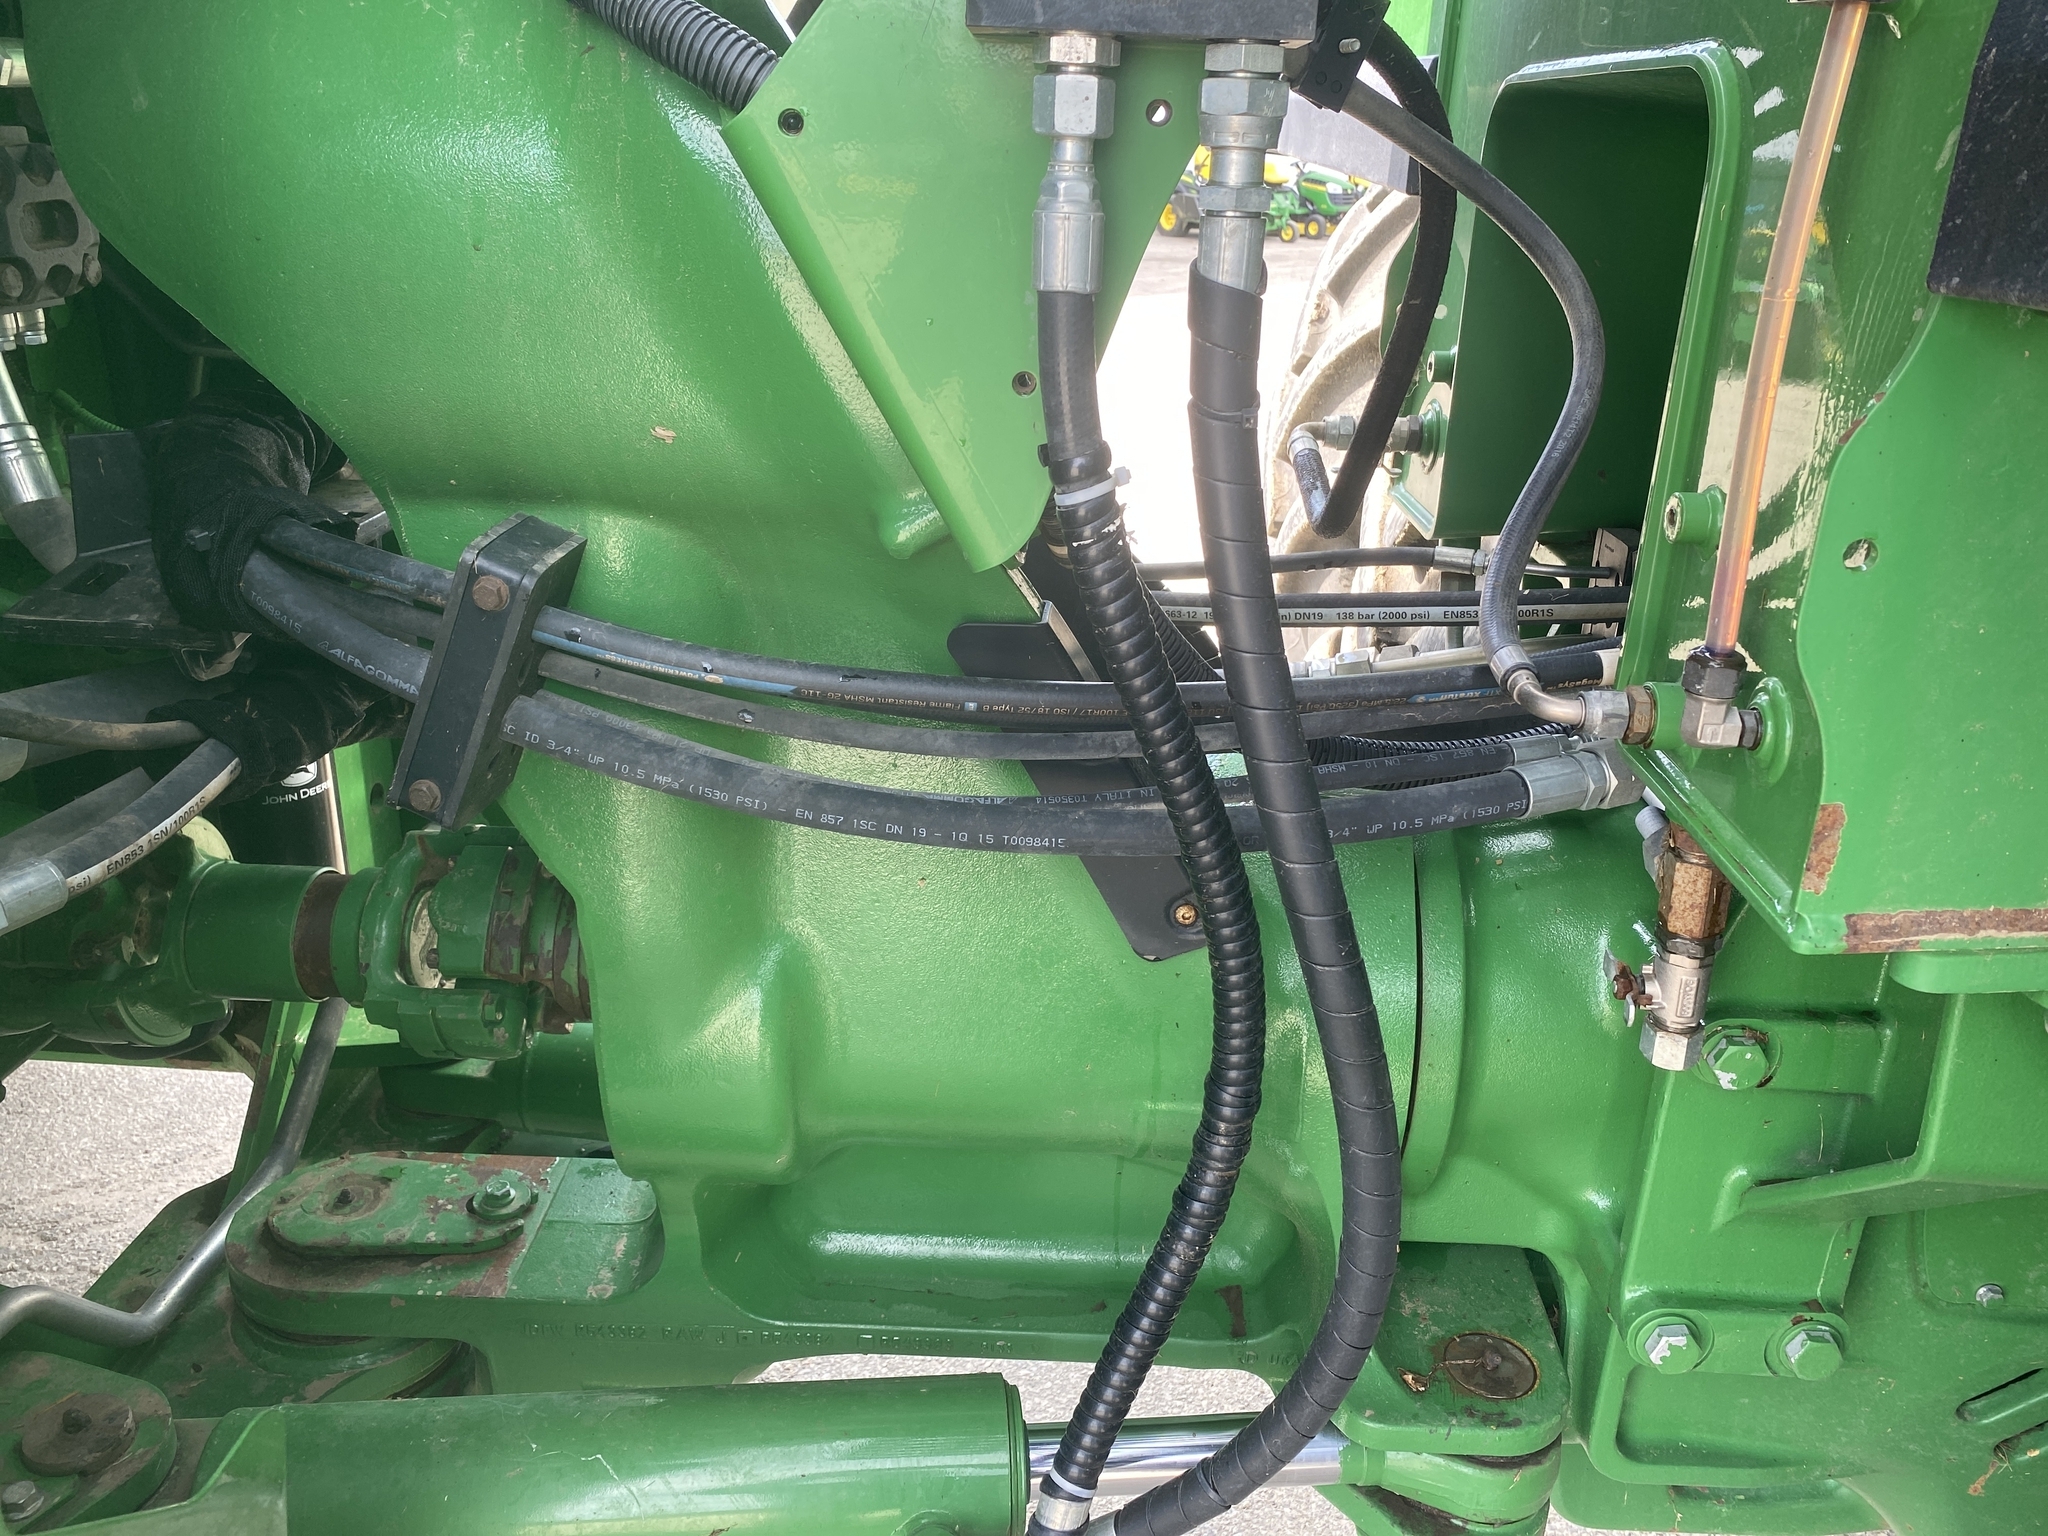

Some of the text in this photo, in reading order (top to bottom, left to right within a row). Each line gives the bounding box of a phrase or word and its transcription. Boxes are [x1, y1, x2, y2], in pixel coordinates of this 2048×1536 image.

[1280, 610, 1479, 621] n) DN19 138 bar (2000 psi) EN853
[1518, 609, 1554, 618] 00R1S
[328, 648, 419, 696] ALFAGOMMA
[652, 665, 699, 679] POWERING
[844, 693, 874, 703] MSHA
[877, 697, 926, 707] Resistant
[929, 702, 961, 711] Flame
[993, 703, 1014, 713] Type
[1054, 707, 1070, 715] ISO
[1452, 749, 1475, 759] 857
[1481, 747, 1497, 756] EN
[1365, 760, 1378, 769] 10
[1385, 757, 1400, 767] DN
[1318, 765, 1346, 775] MSHA
[524, 731, 540, 744] ID
[588, 754, 605, 765] WP
[614, 762, 646, 779] 10.5
[653, 774, 680, 789] MPa
[689, 784, 729, 802] (1530
[736, 795, 768, 811] PSI)
[795, 808, 813, 820] EN
[820, 813, 844, 826] 857
[852, 819, 877, 831] 1SC
[886, 824, 903, 835] DN
[912, 827, 926, 837] 19
[978, 834, 994, 845] 15
[1003, 835, 1066, 848] T0098415
[1140, 788, 1154, 797] IN
[262, 793, 298, 805] JOHN
[1036, 795, 1087, 804] T0350514
[1094, 791, 1131, 801] ITALY
[1367, 823, 1383, 834] WP
[1392, 818, 1423, 830] 10.5
[1431, 814, 1455, 826] MPa
[1463, 806, 1500, 820] (1530
[106, 845, 144, 875] EN853
